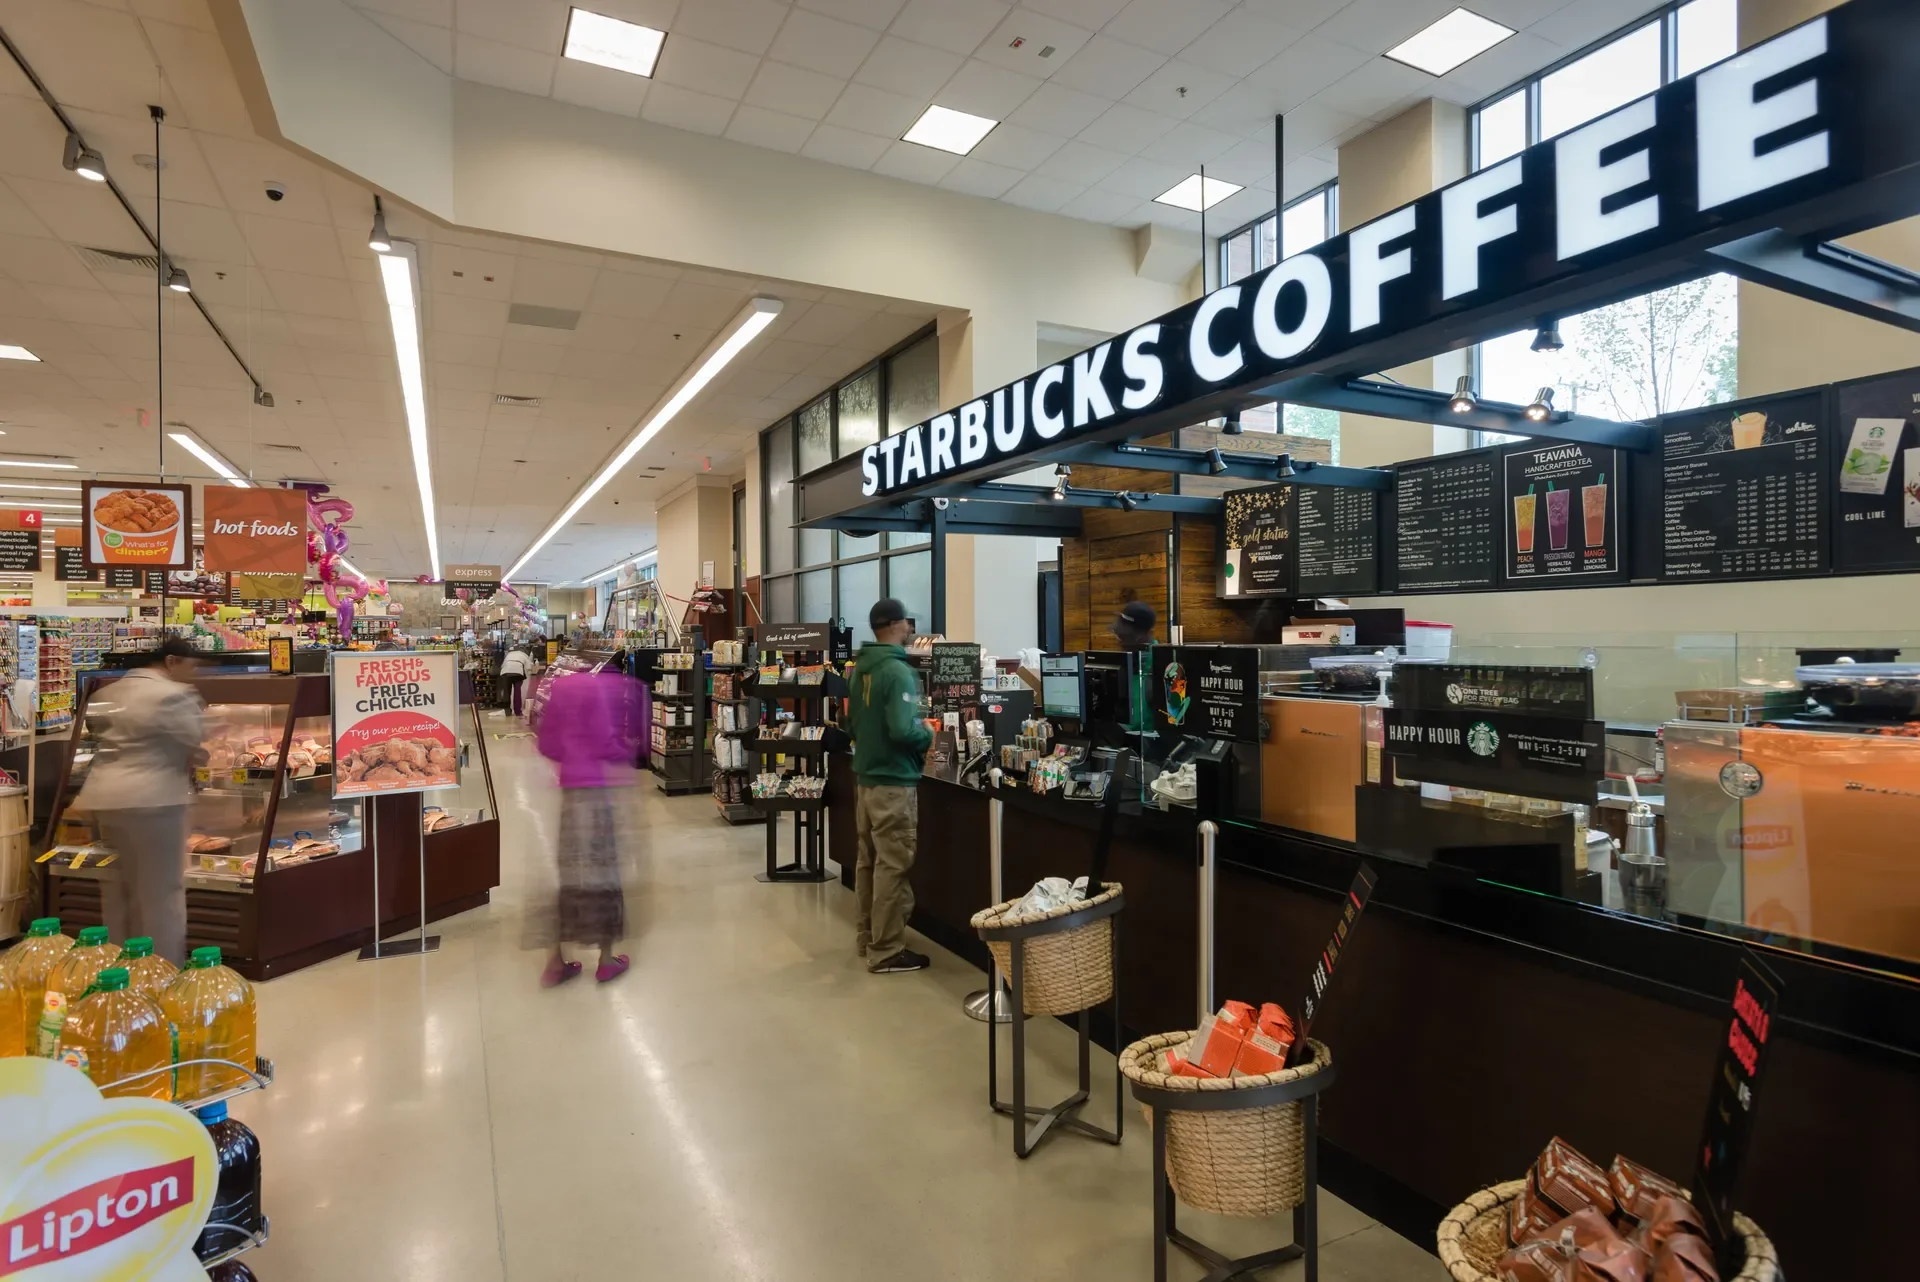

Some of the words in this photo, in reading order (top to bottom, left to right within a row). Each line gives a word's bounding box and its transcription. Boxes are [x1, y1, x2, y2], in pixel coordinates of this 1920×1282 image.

[861, 321, 1168, 498] STARBUCKS
[1194, 15, 1829, 384] COFFEE
[1664, 436, 1692, 444] Smoothies
[1534, 447, 1582, 464] TEAVANA
[1525, 460, 1576, 474] HANDCRAFTED
[26, 514, 35, 524] 4
[1845, 513, 1864, 521] COOL
[1867, 511, 1885, 520] LIME
[212, 518, 248, 534] hot
[250, 520, 298, 538] foods
[1242, 528, 1261, 547] gold
[1262, 526, 1289, 540] status
[115, 547, 169, 556] dinner?
[1584, 549, 1606, 557] MANGO
[455, 569, 492, 577] express
[940, 657, 964, 666] PIKE
[940, 666, 971, 674] PLACE
[356, 669, 431, 688] FAMOUS
[1200, 677, 1222, 689] HAPPY
[1224, 678, 1243, 690] HOUR
[370, 683, 420, 698] FRIED
[356, 693, 435, 713] CHICKEN
[1210, 707, 1220, 716] MAY
[350, 729, 370, 740] Try
[413, 721, 441, 732] recipe!
[1224, 719, 1232, 728] PM
[1389, 725, 1423, 742] HAPPY
[1429, 727, 1460, 745] HOUR
[1518, 741, 1532, 750] MAY
[1575, 747, 1587, 757] PM
[9, 1174, 179, 1264] Lipton
